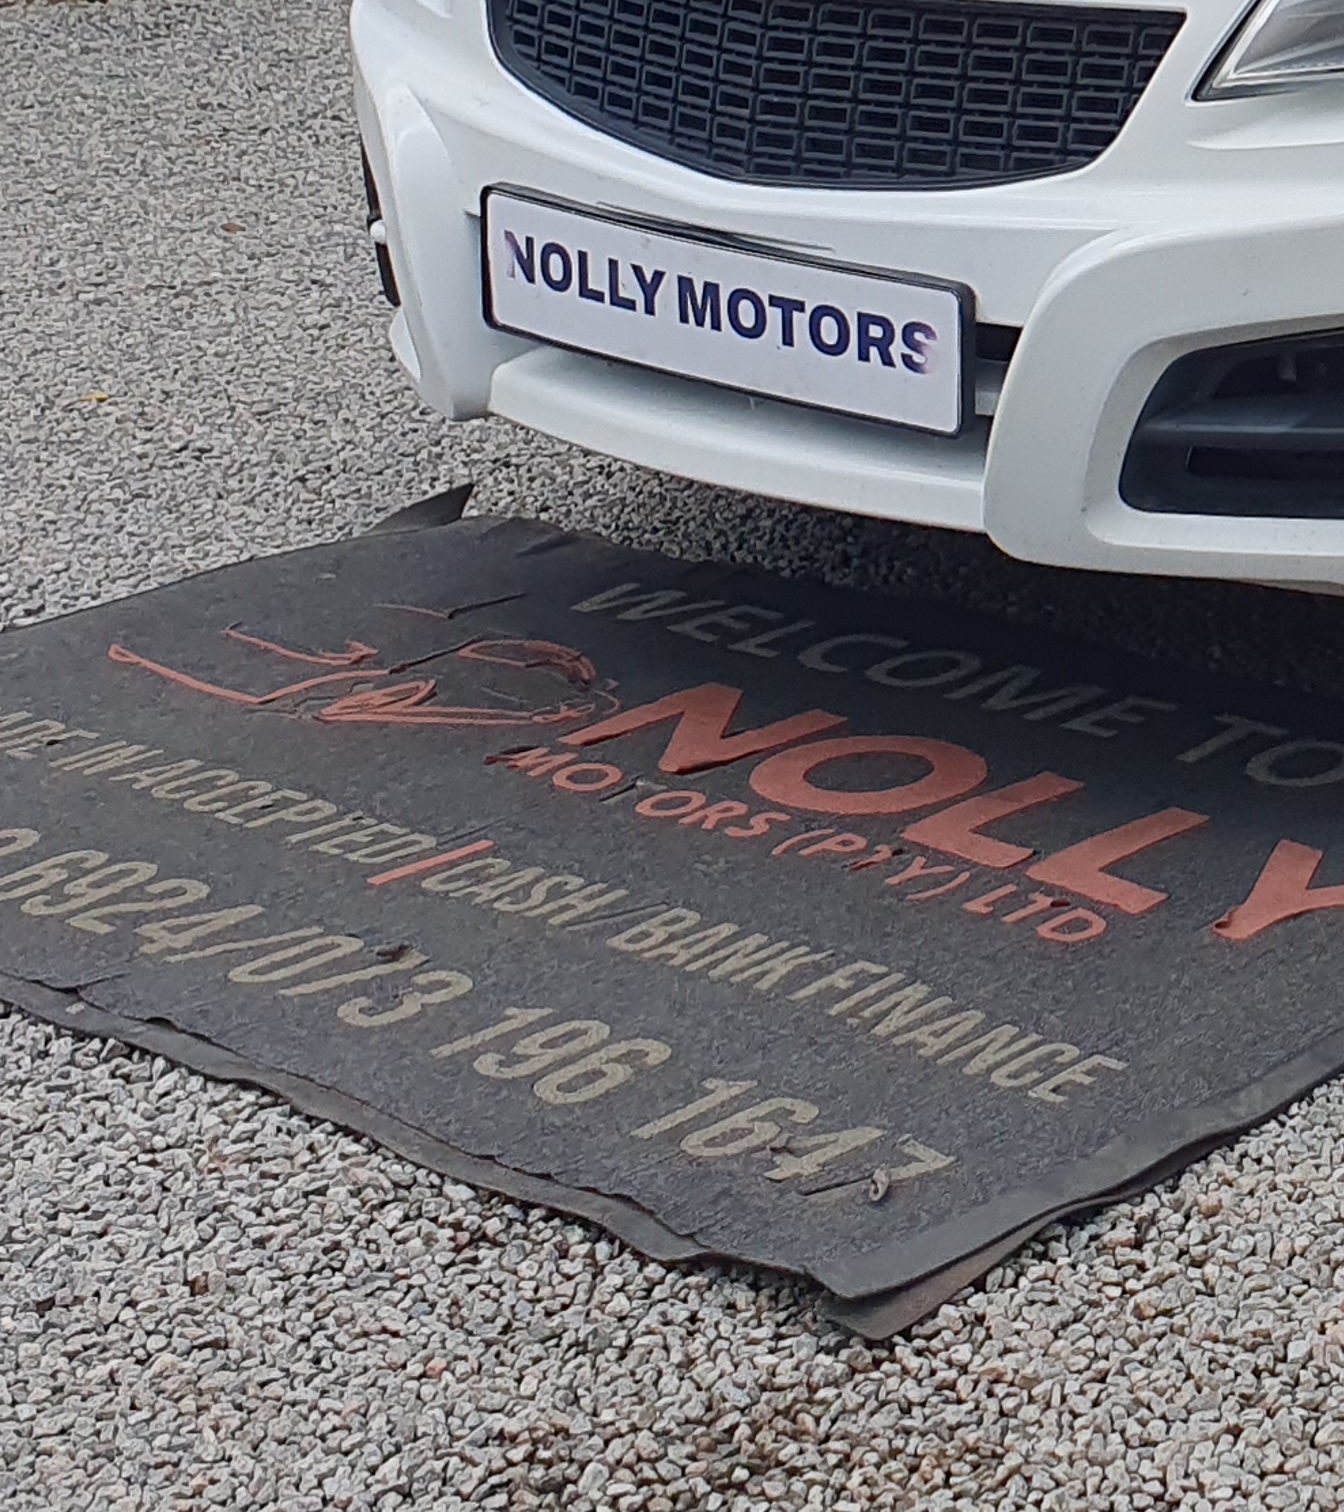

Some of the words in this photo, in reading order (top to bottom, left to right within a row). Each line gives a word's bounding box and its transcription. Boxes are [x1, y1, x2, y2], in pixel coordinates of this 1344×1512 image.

[503, 230, 666, 317] NOLLY
[677, 274, 938, 375] MOTORS
[570, 581, 1178, 739] WELCOME
[484, 746, 792, 838] MOORS
[48, 739, 165, 776] IN
[107, 757, 439, 866] ACCEPTED
[787, 959, 1131, 1105] FINANCE
[428, 1006, 673, 1107] 196
[629, 1078, 959, 1205] 1647
